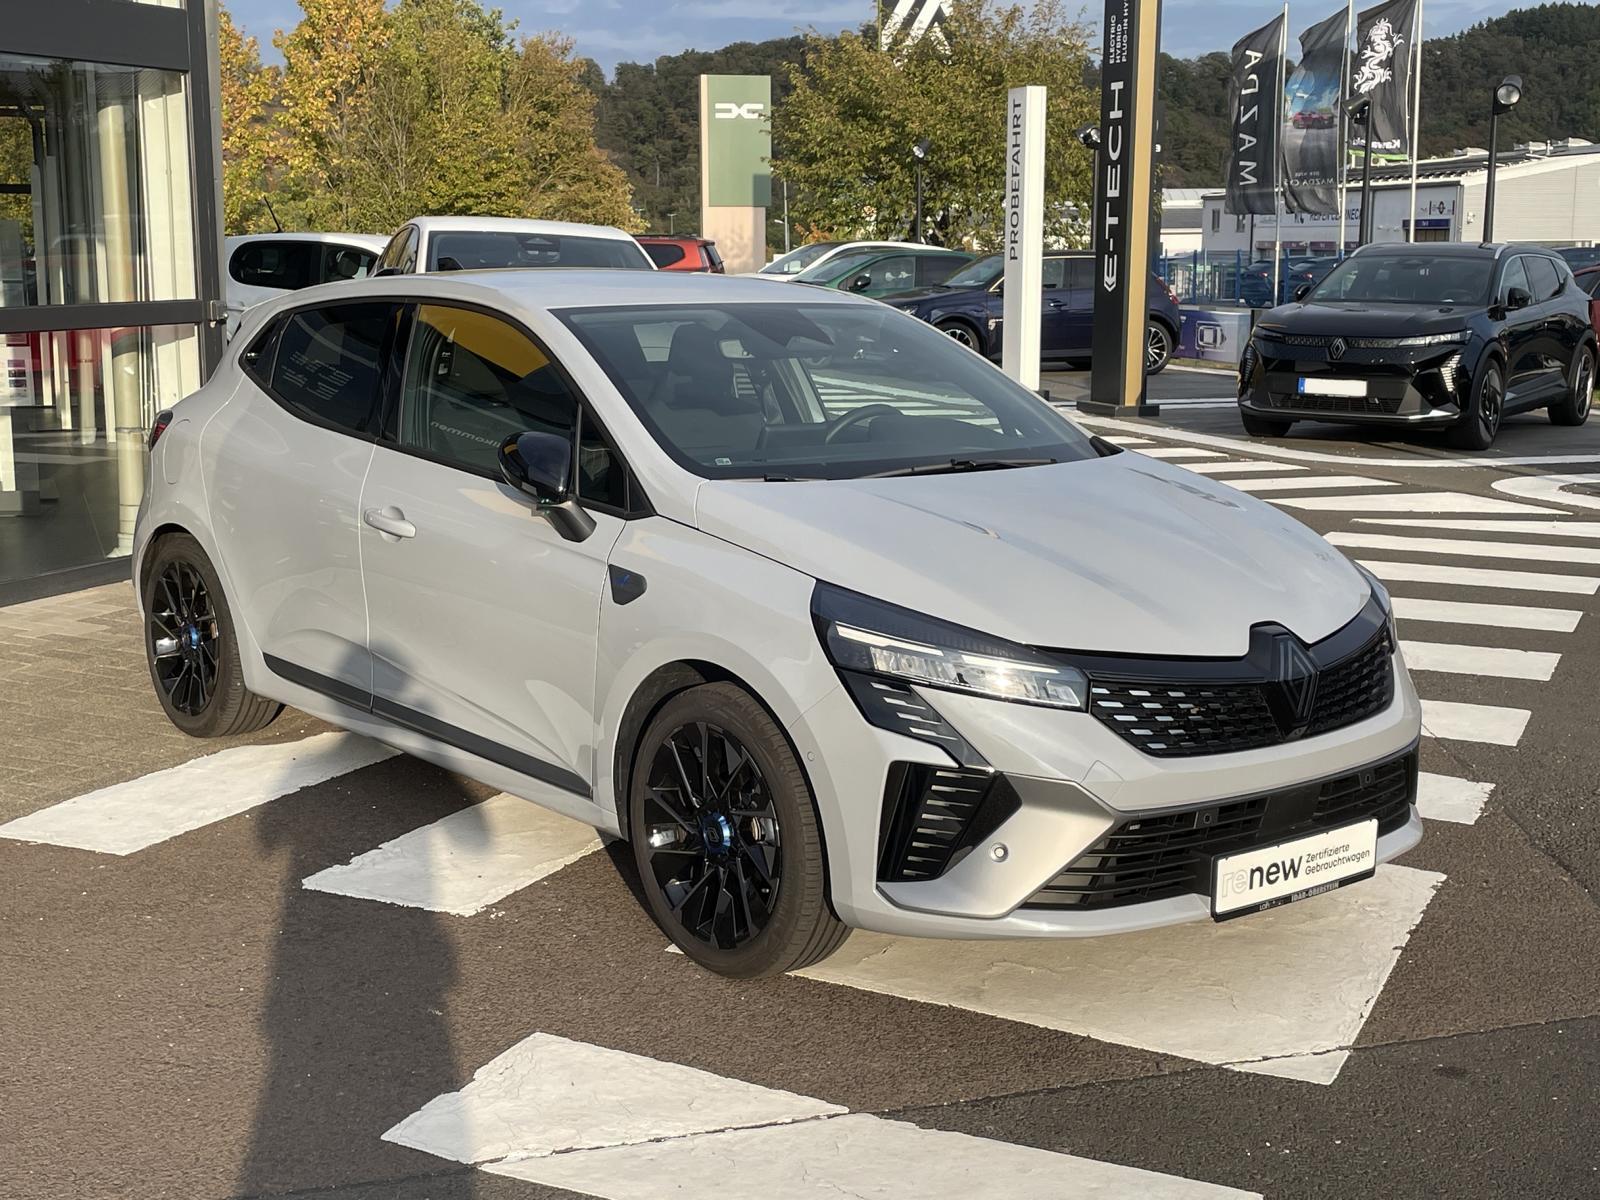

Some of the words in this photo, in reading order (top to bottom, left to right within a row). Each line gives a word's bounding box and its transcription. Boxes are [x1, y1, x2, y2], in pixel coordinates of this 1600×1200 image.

[1009, 98, 1022, 260] PROBEFAHRT
[1103, 81, 1124, 292] E-TECH
[1222, 855, 1303, 898] renew
[1304, 849, 1371, 876] Gebrauchtwagen
[1305, 843, 1350, 863] Zertifizierte
